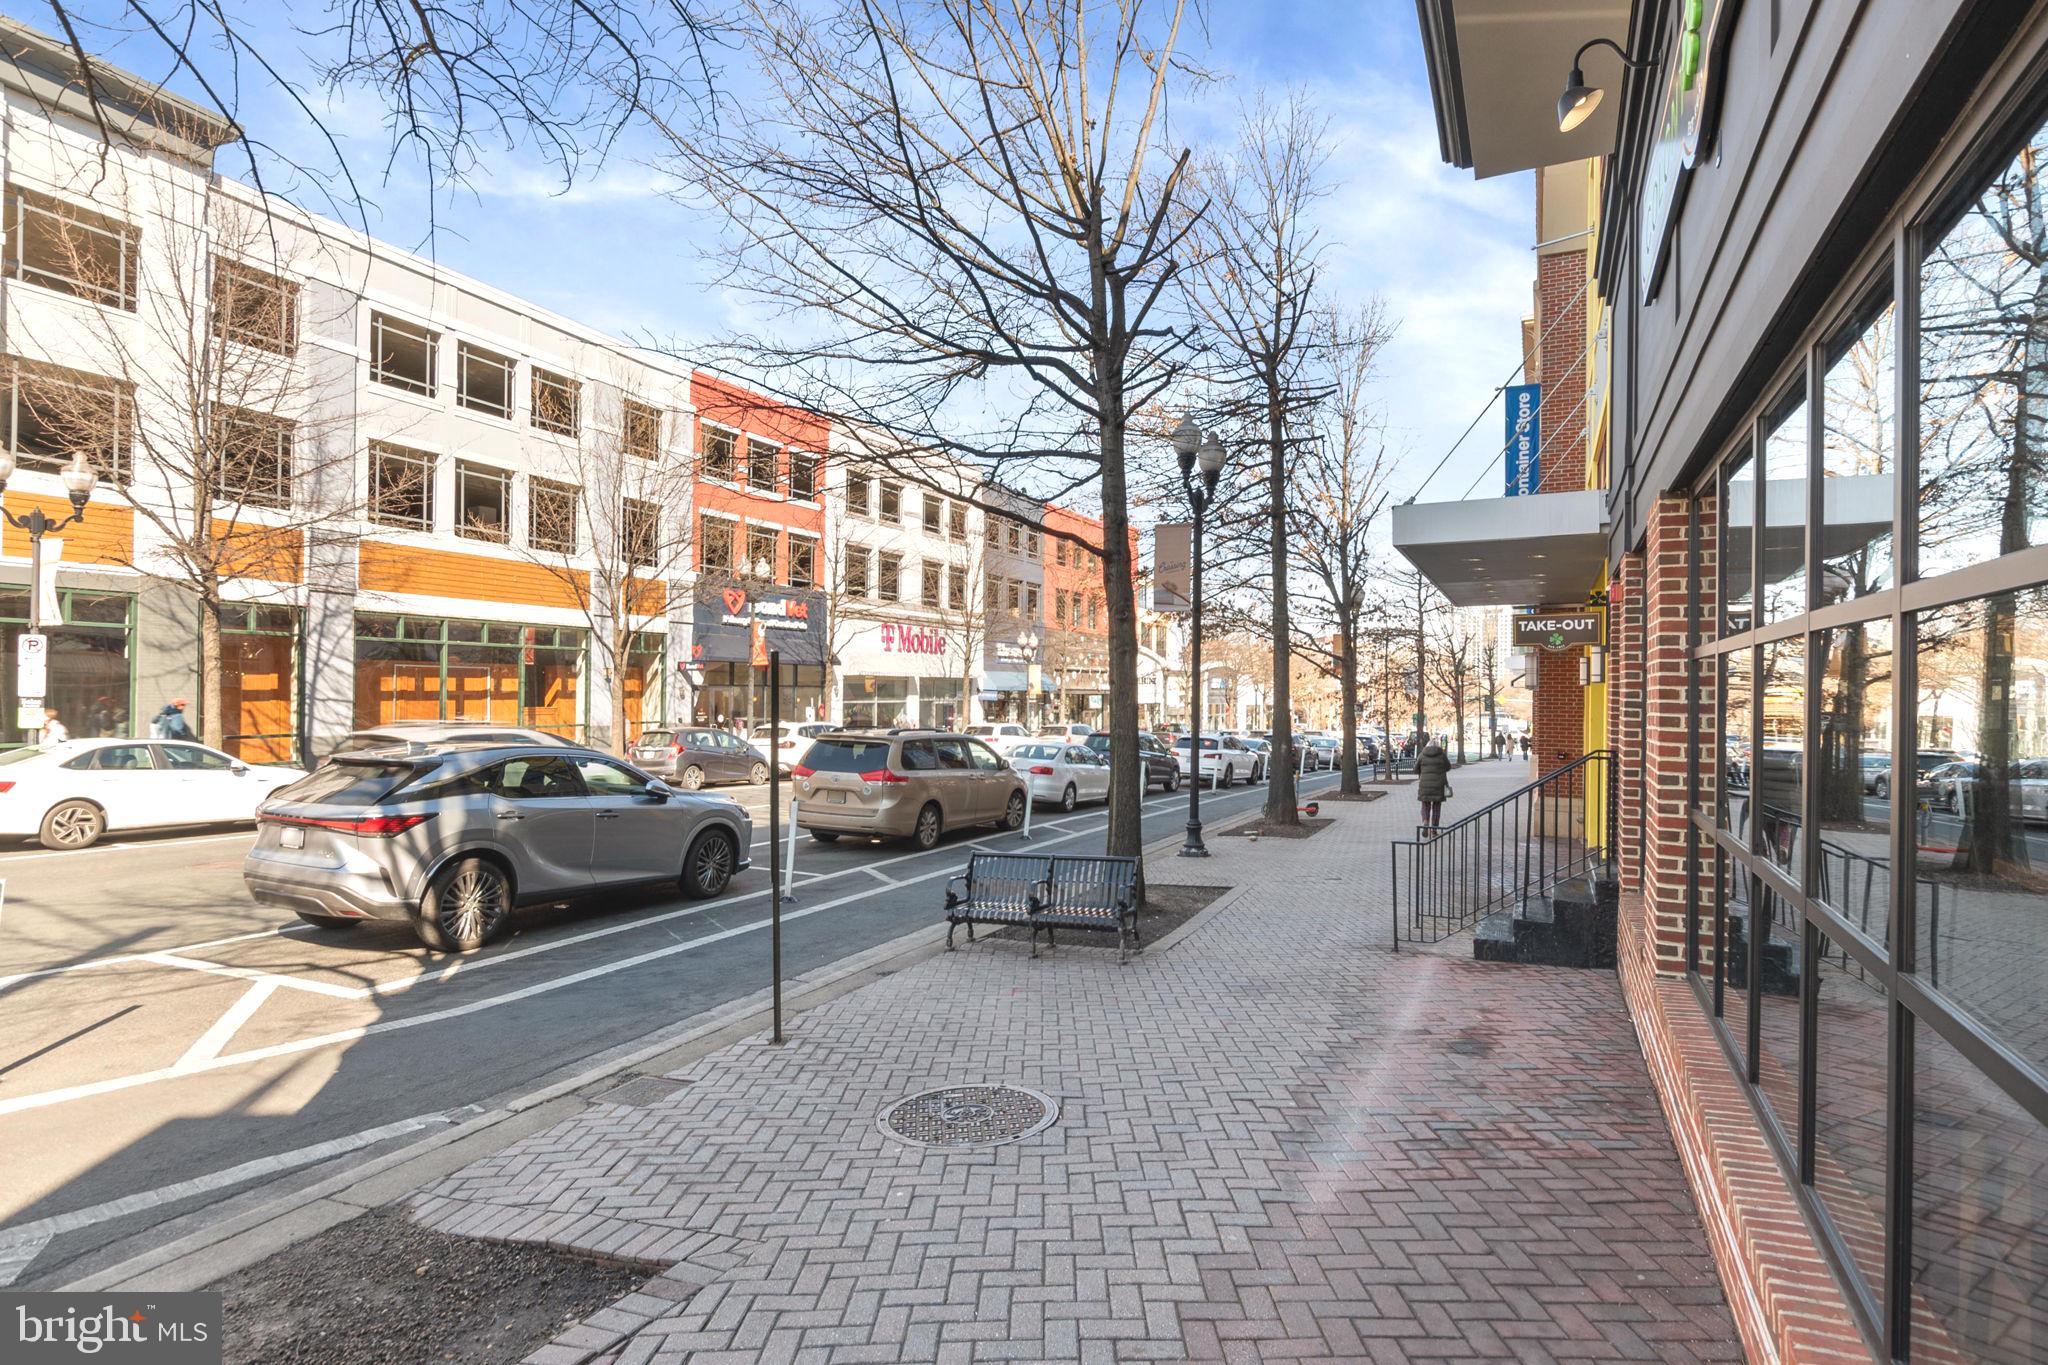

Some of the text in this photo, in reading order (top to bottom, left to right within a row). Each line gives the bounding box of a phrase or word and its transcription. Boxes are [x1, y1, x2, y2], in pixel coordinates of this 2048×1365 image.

[1515, 392, 1531, 497] ontainer Store
[1518, 619, 1595, 632] TAKE-OUT
